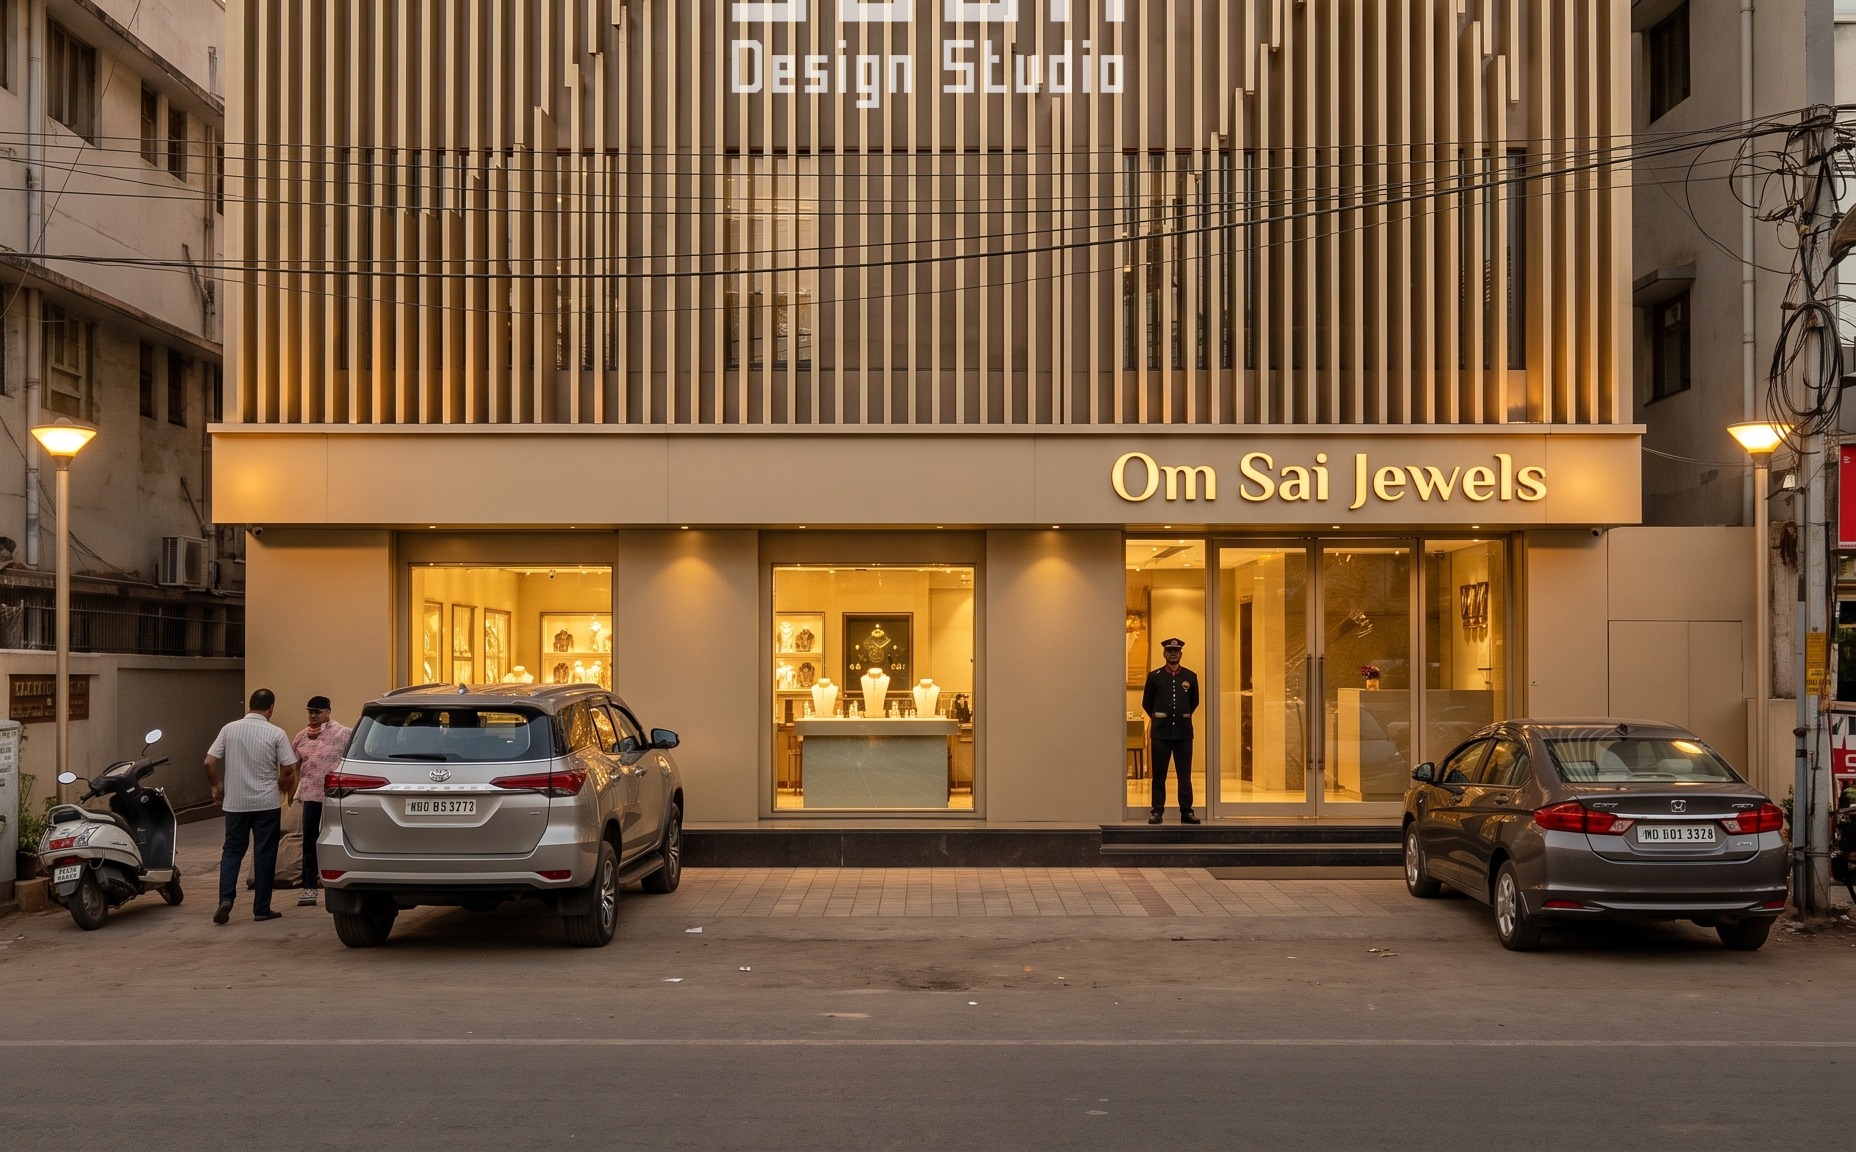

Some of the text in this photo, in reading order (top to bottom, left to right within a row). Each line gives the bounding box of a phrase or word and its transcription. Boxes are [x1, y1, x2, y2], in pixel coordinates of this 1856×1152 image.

[1111, 451, 1547, 509] Om Sai Jewels
